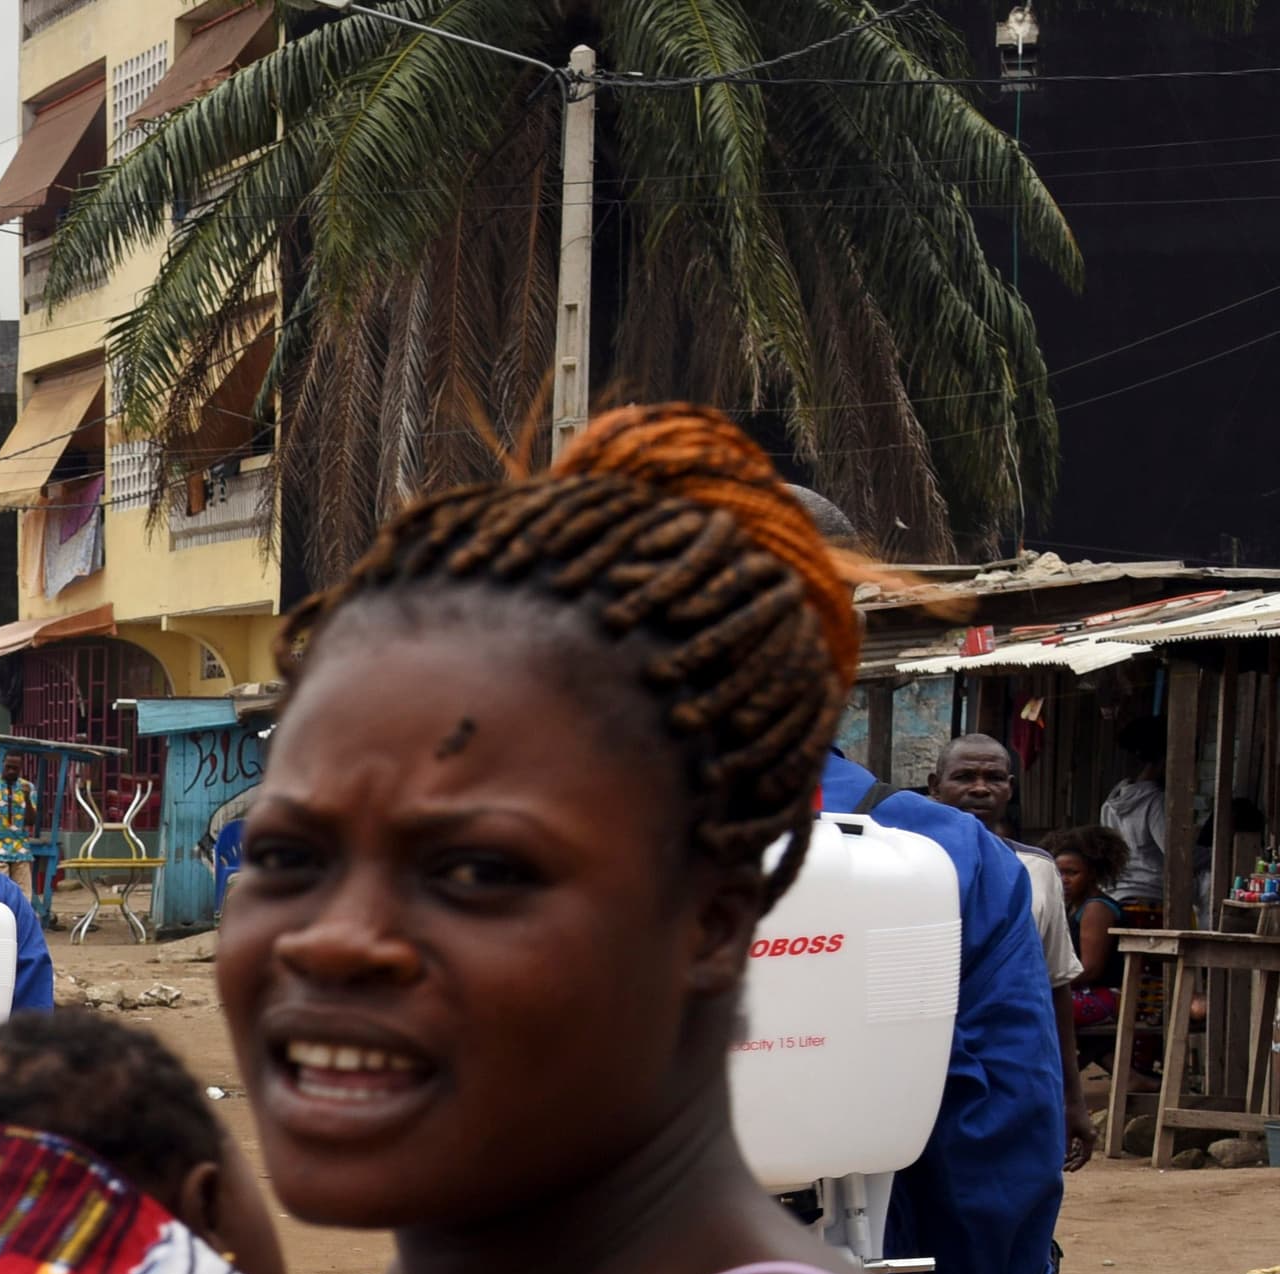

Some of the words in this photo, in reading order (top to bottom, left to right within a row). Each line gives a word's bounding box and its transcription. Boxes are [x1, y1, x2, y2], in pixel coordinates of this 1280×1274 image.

[749, 934, 844, 958] OBOSS
[778, 1037, 795, 1049] 15
[799, 1036, 825, 1048] Liter
